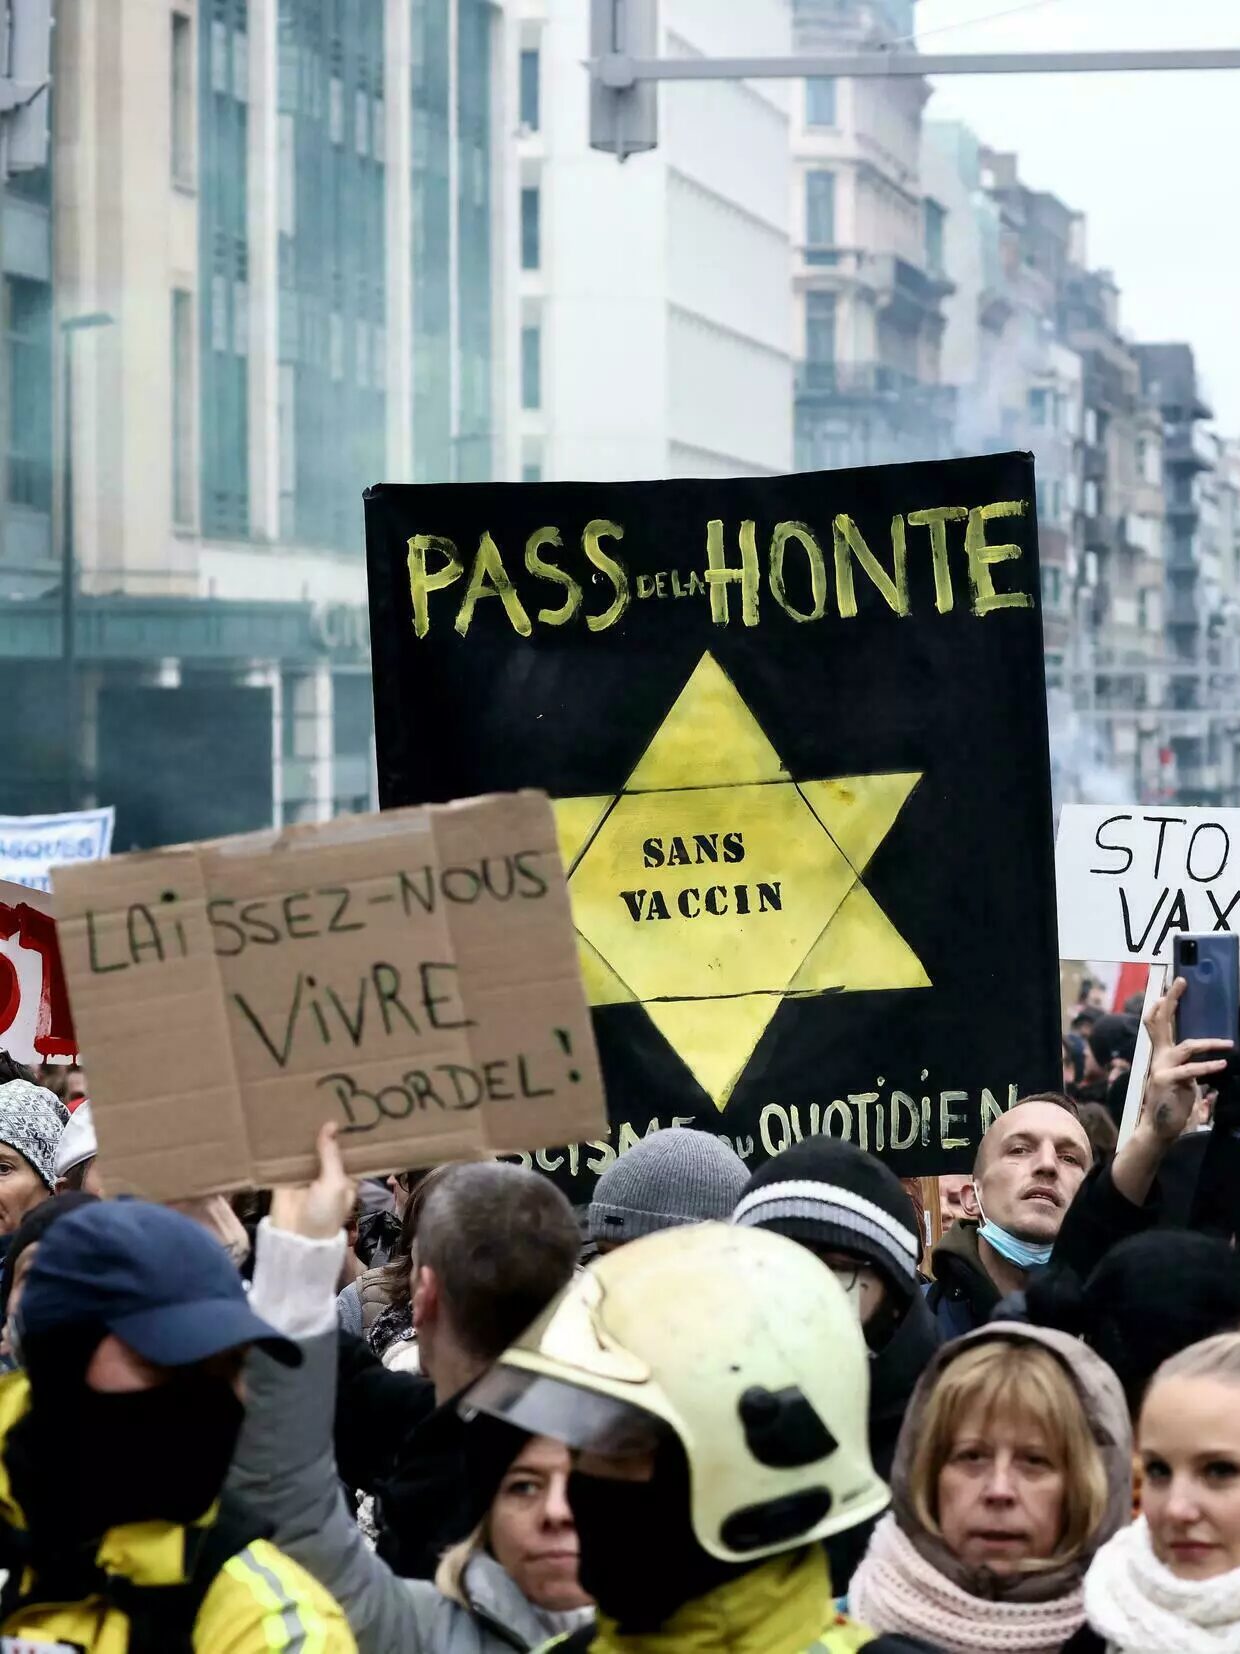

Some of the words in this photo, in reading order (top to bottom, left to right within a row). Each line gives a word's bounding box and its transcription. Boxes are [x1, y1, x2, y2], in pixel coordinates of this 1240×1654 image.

[407, 519, 631, 639] PASS
[704, 500, 1035, 628] HONTE
[642, 832, 746, 869] SANS
[619, 881, 783, 922] VACCIN
